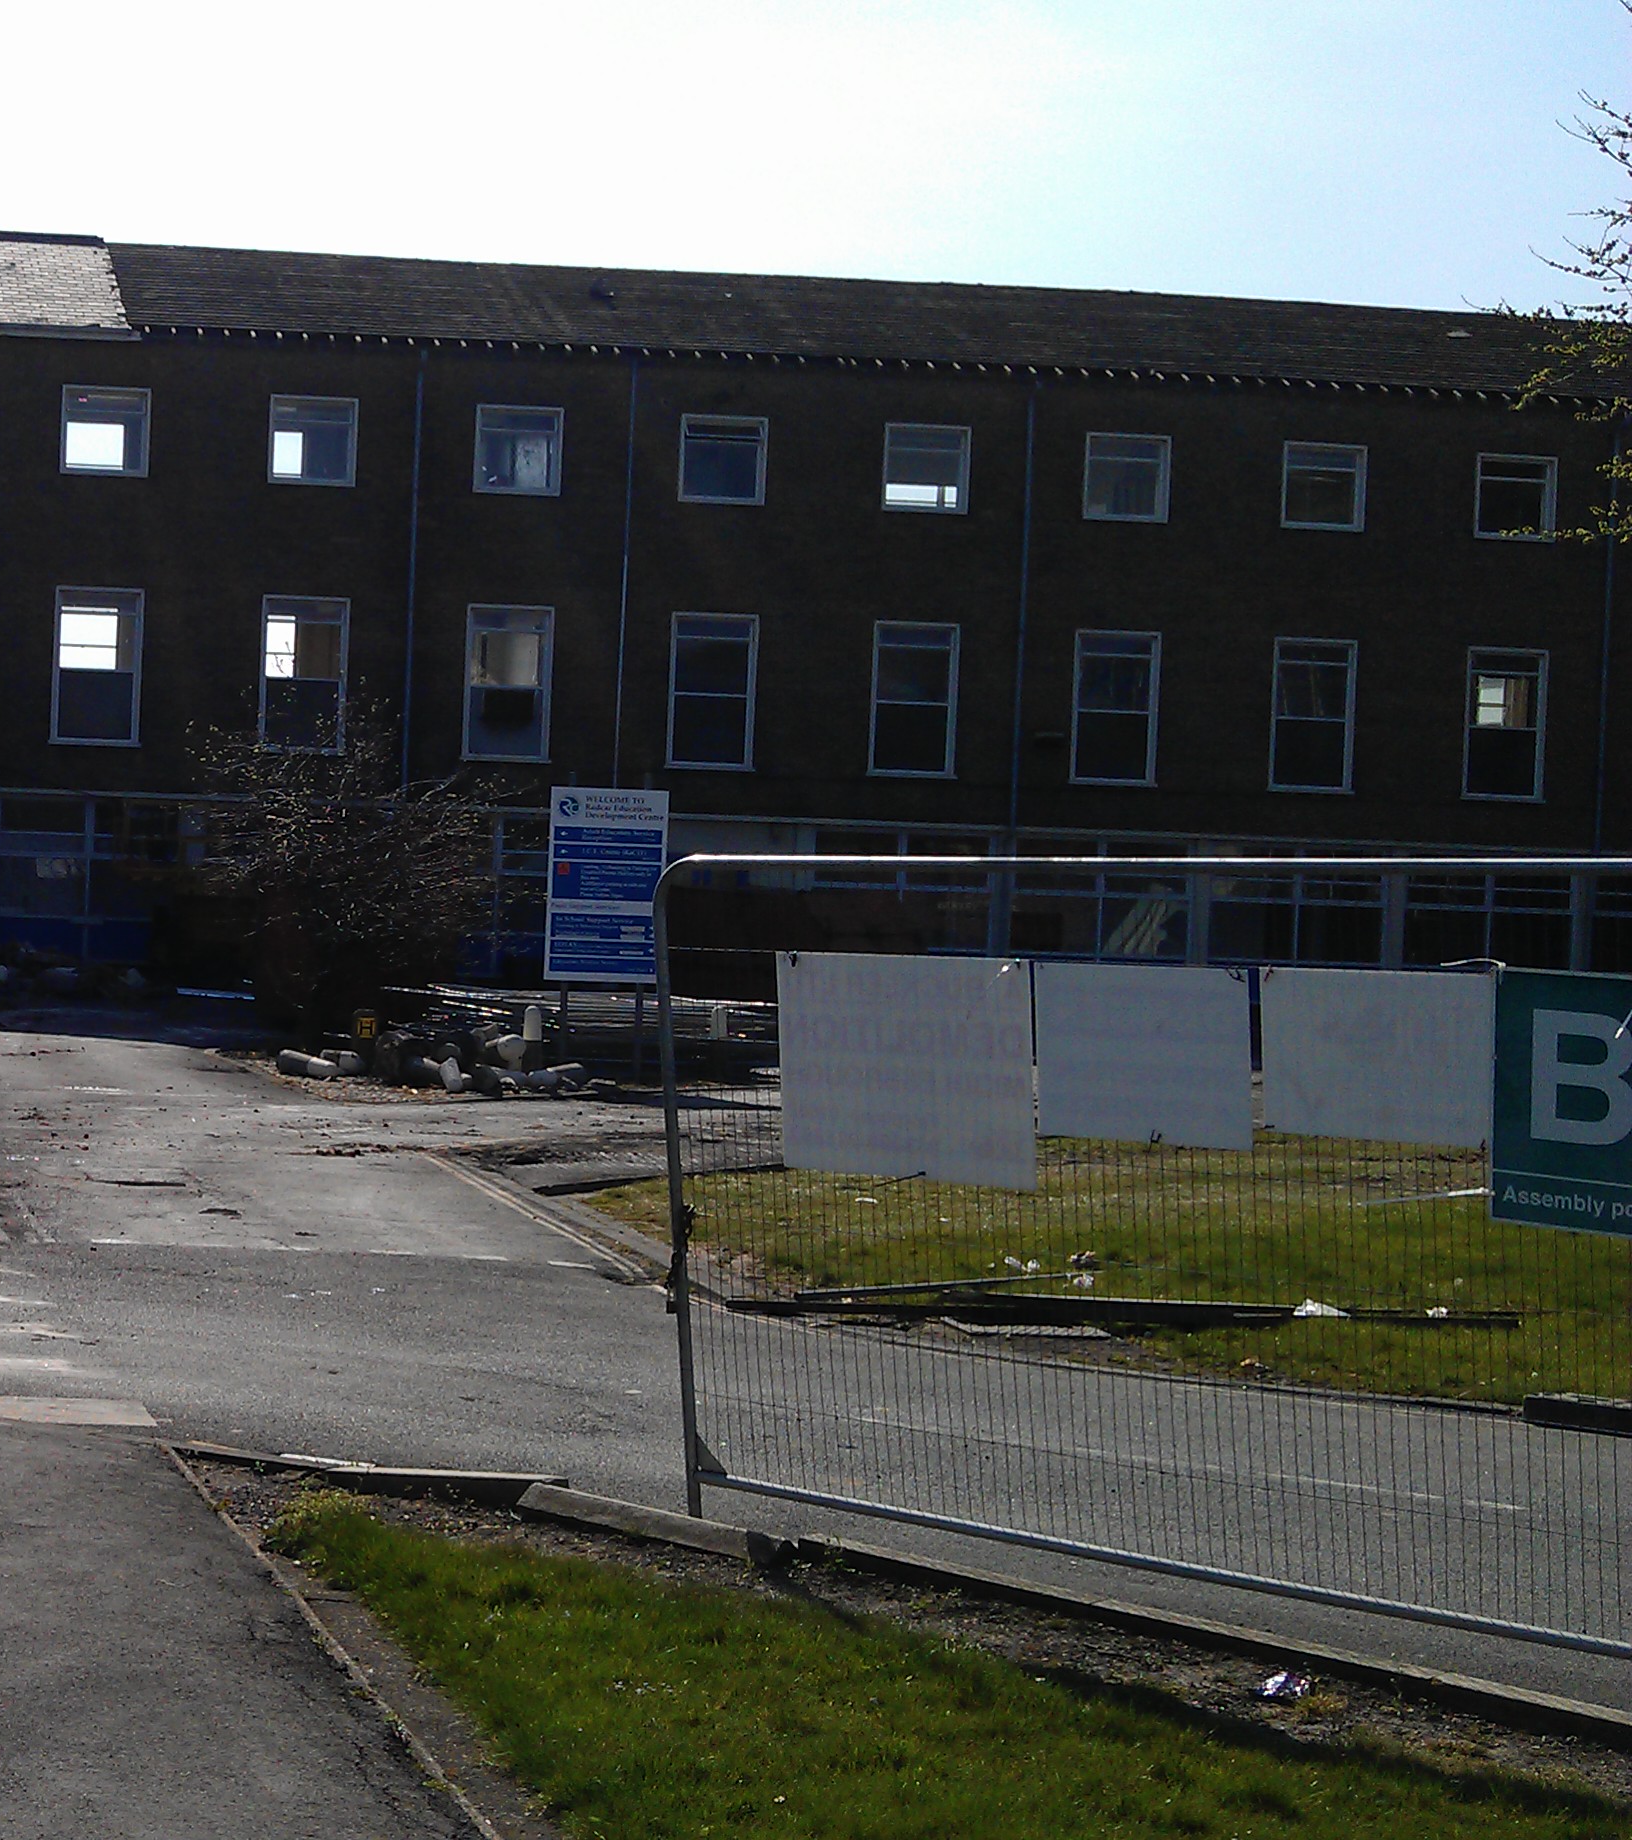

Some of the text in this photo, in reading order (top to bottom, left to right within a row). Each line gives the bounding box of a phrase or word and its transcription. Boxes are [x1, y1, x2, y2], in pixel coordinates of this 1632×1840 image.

[585, 812, 637, 821] Development
[1530, 1008, 1632, 1146] B
[1502, 1185, 1605, 1217] Assembly
